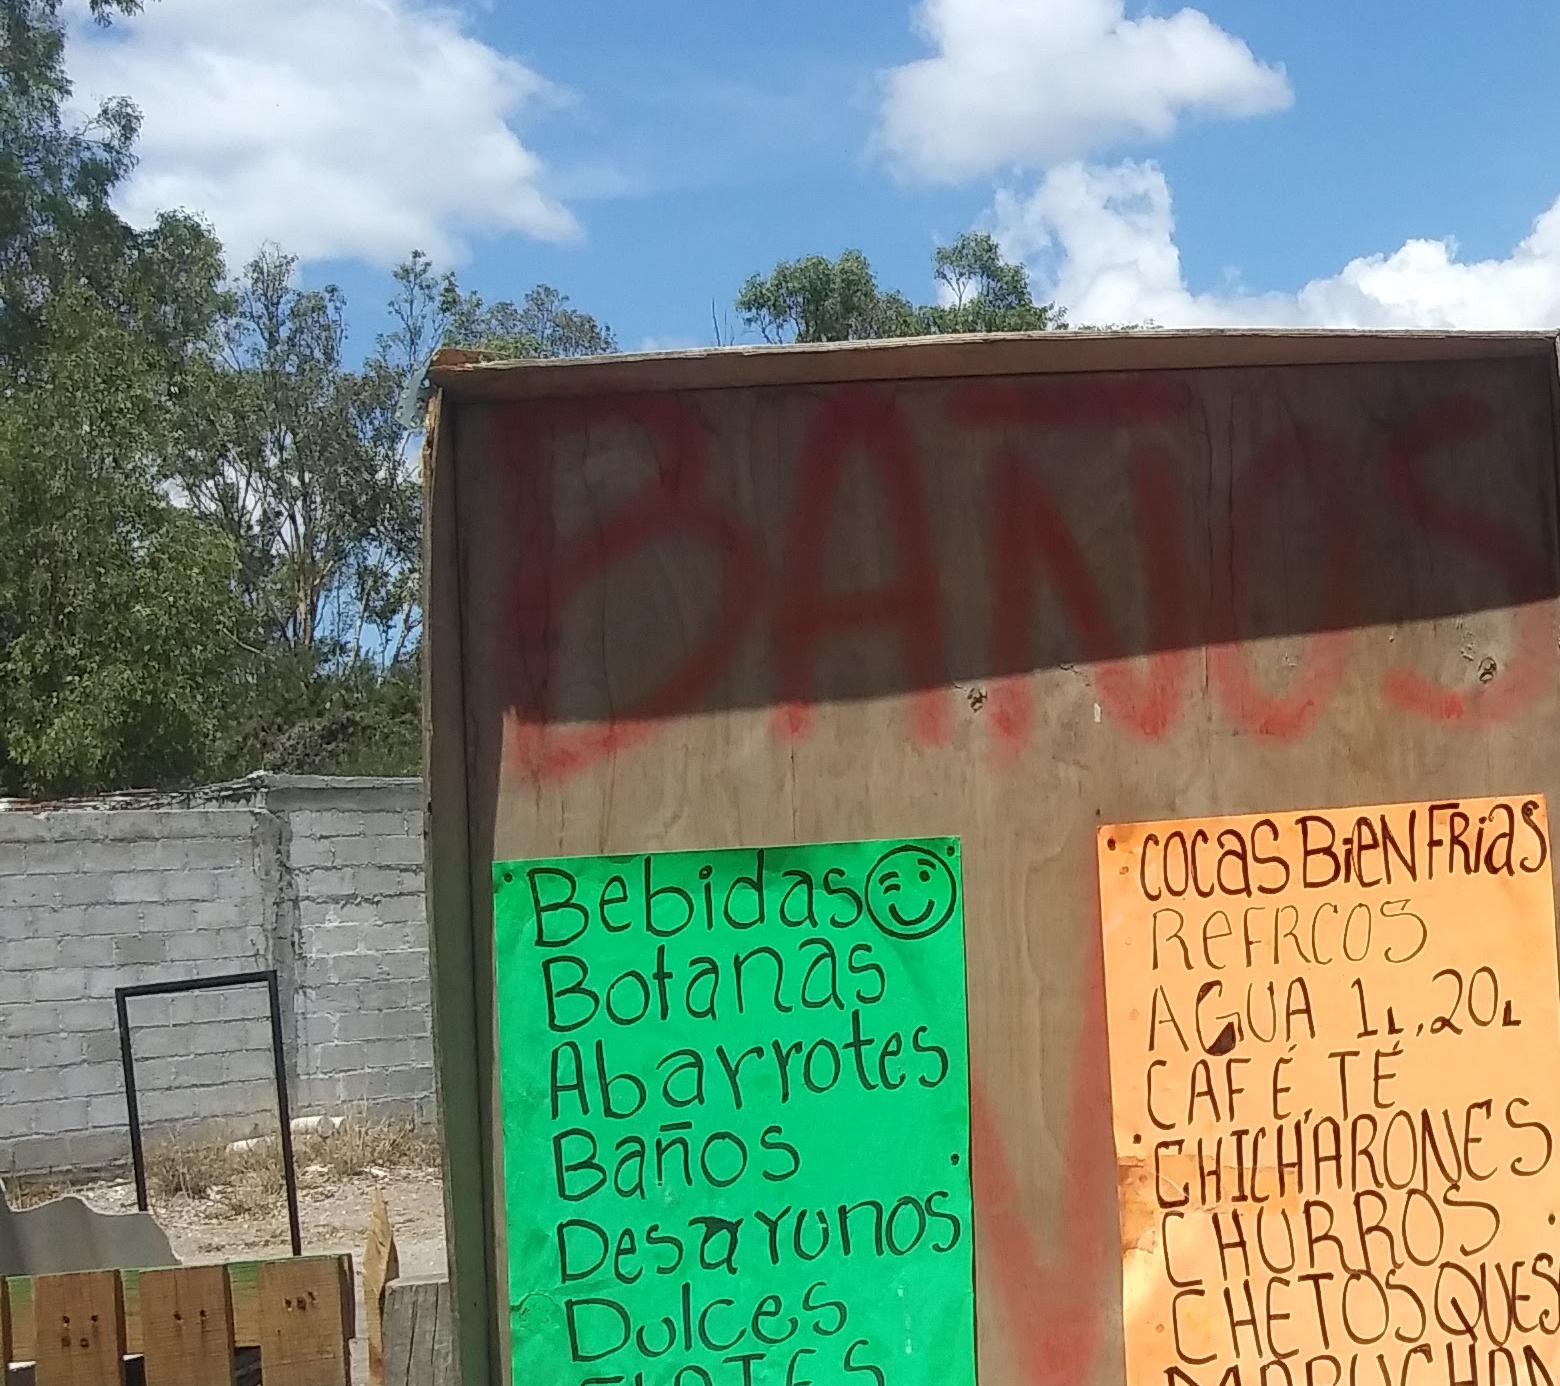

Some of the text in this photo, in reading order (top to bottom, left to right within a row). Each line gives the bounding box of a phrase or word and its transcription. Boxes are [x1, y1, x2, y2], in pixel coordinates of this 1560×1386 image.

[527, 849, 864, 947] Bebidas
[542, 937, 887, 1033] Botanas
[1147, 976, 1316, 1056] AGUA
[549, 1009, 950, 1120] Abarrotes
[1327, 1040, 1406, 1113] TÉ
[552, 1121, 802, 1202] Baños
[1153, 1097, 1553, 1210] CHICHARONES
[1161, 1181, 1502, 1290] CHURROS
[563, 1280, 849, 1363] Dulces
[1171, 1266, 1427, 1366] CHETOS
